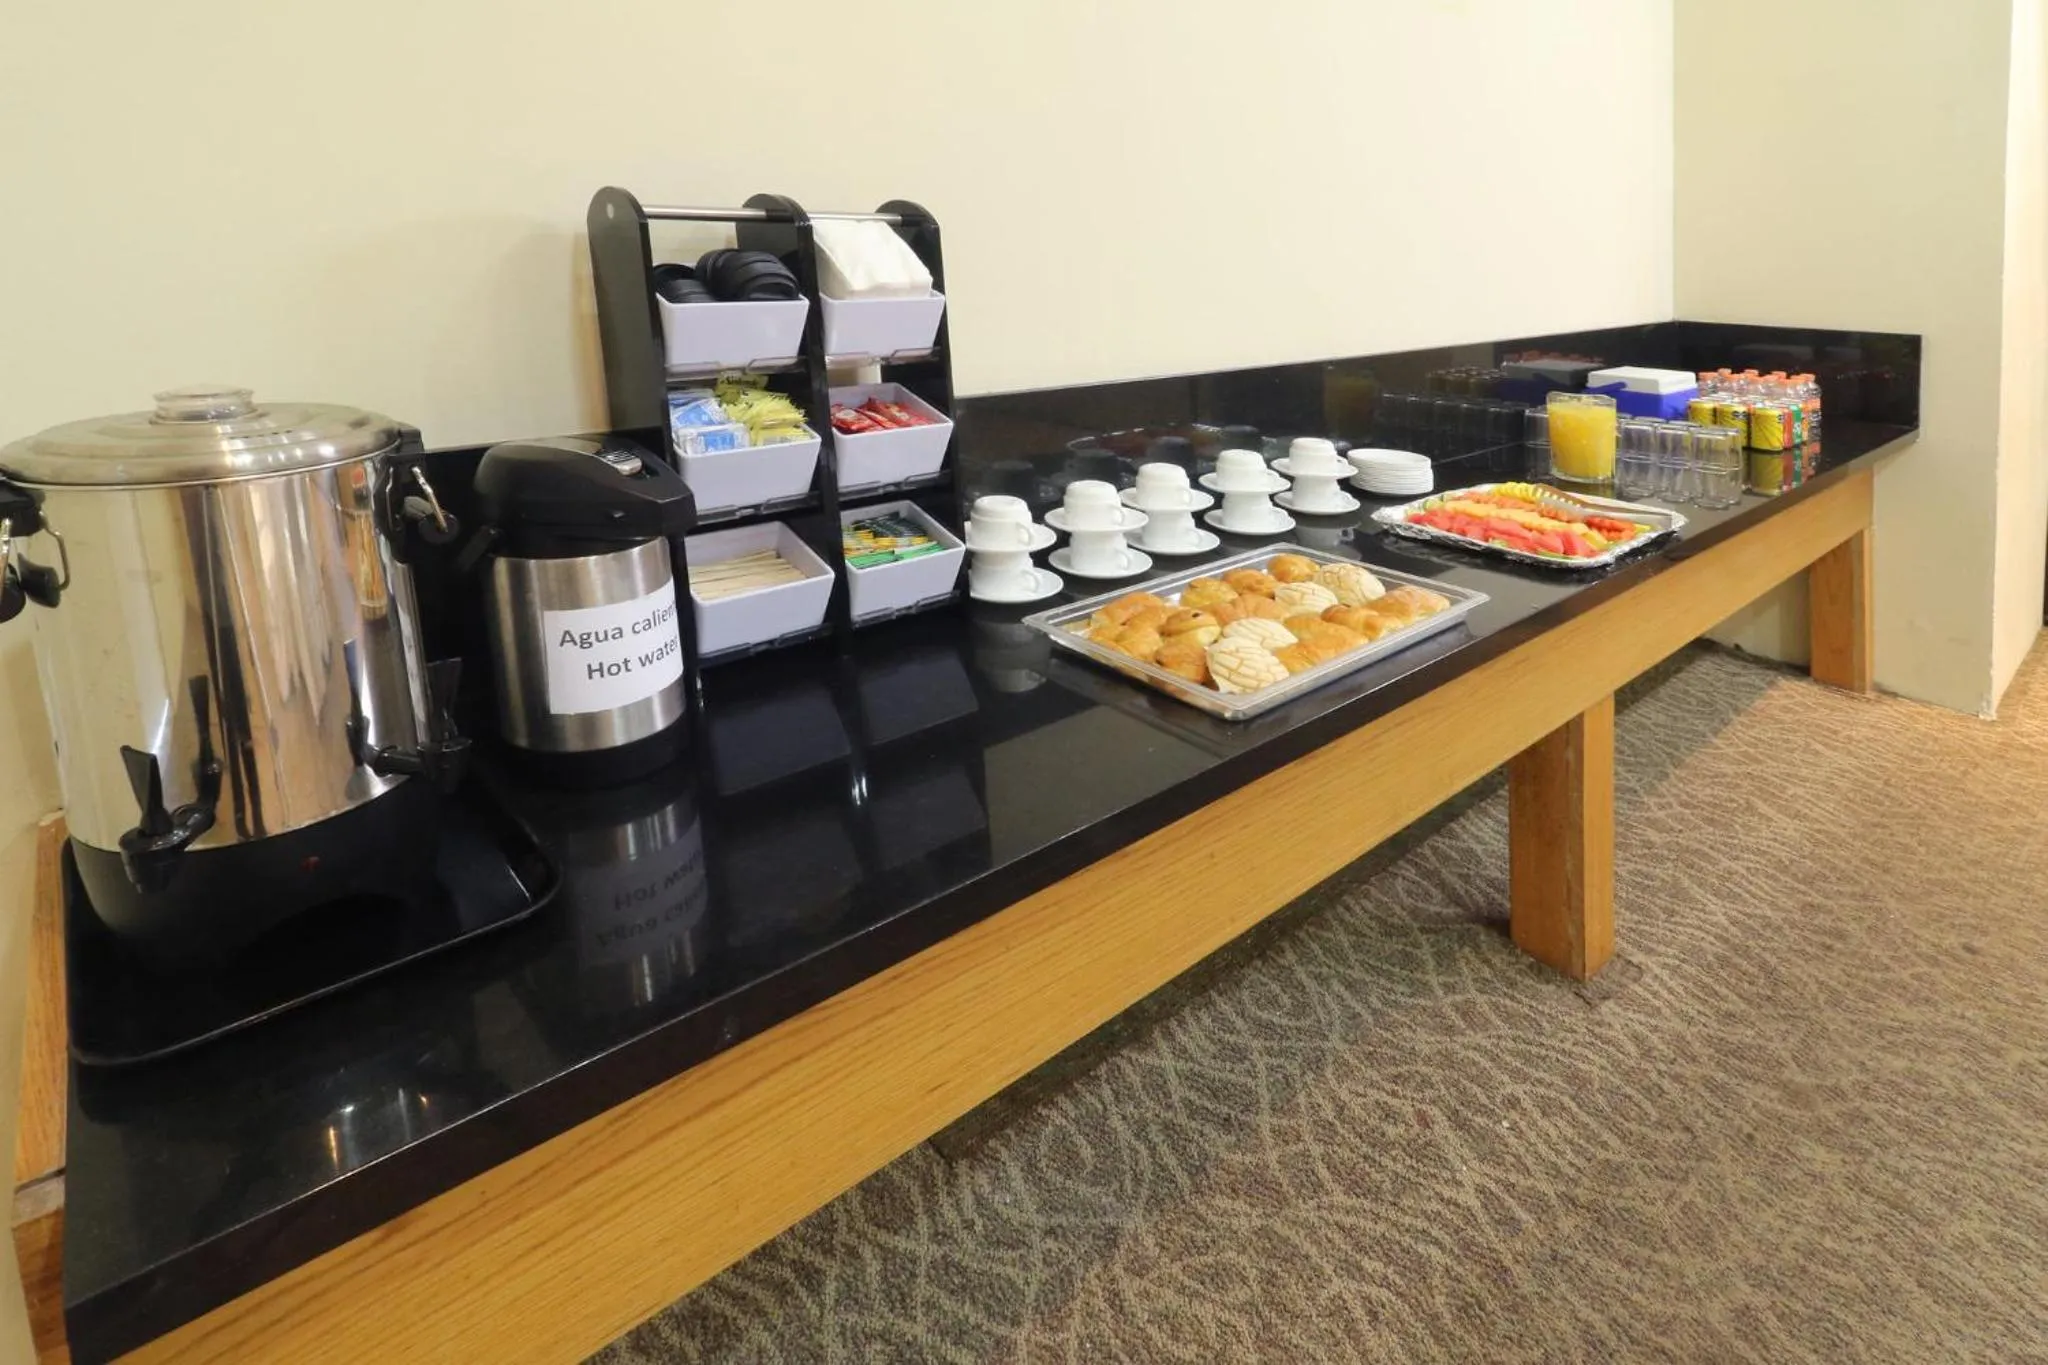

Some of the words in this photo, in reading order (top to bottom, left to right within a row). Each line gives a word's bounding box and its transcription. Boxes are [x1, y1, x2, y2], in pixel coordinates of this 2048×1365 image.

[559, 626, 623, 649] Agua
[631, 601, 676, 635] calien
[587, 658, 631, 680] Hot
